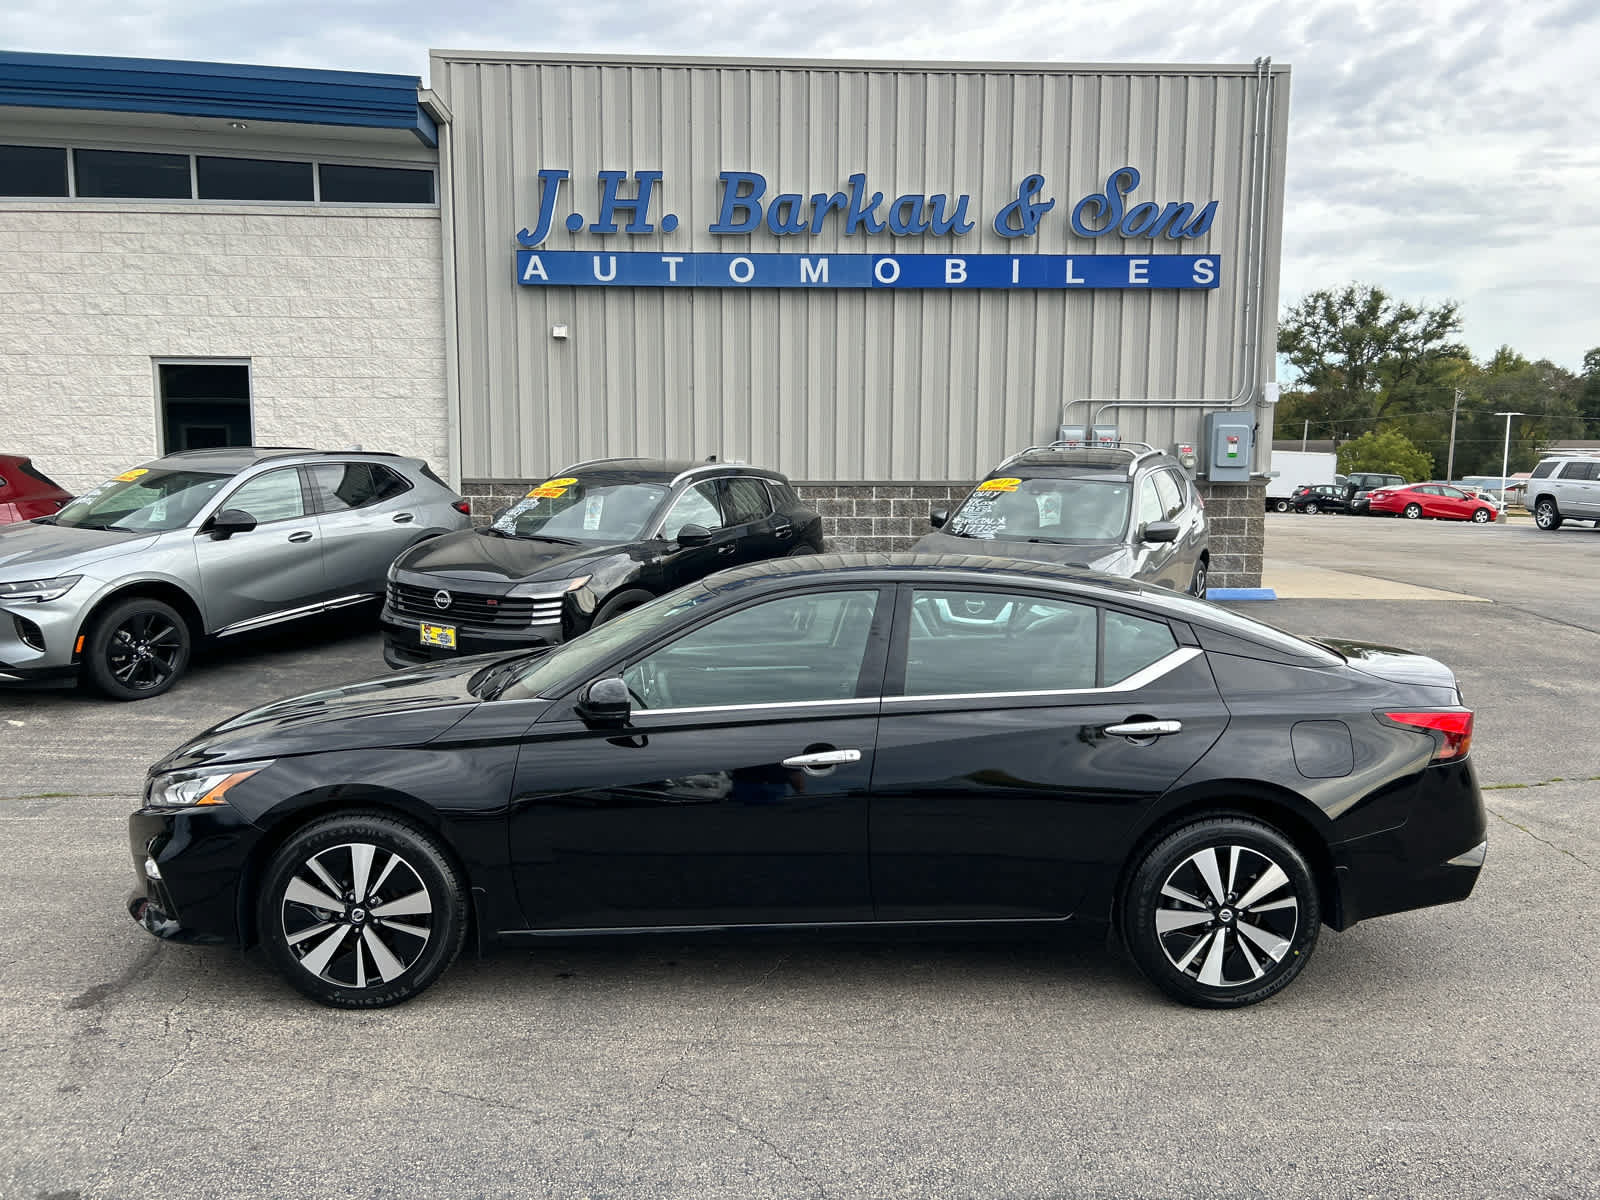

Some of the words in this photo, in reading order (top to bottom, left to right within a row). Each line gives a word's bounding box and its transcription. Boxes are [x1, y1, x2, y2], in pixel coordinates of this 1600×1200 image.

[708, 171, 976, 237] Barkau
[993, 173, 1056, 240] &
[1070, 166, 1220, 241] Sons
[523, 254, 1215, 285] AUTOMOBILES
